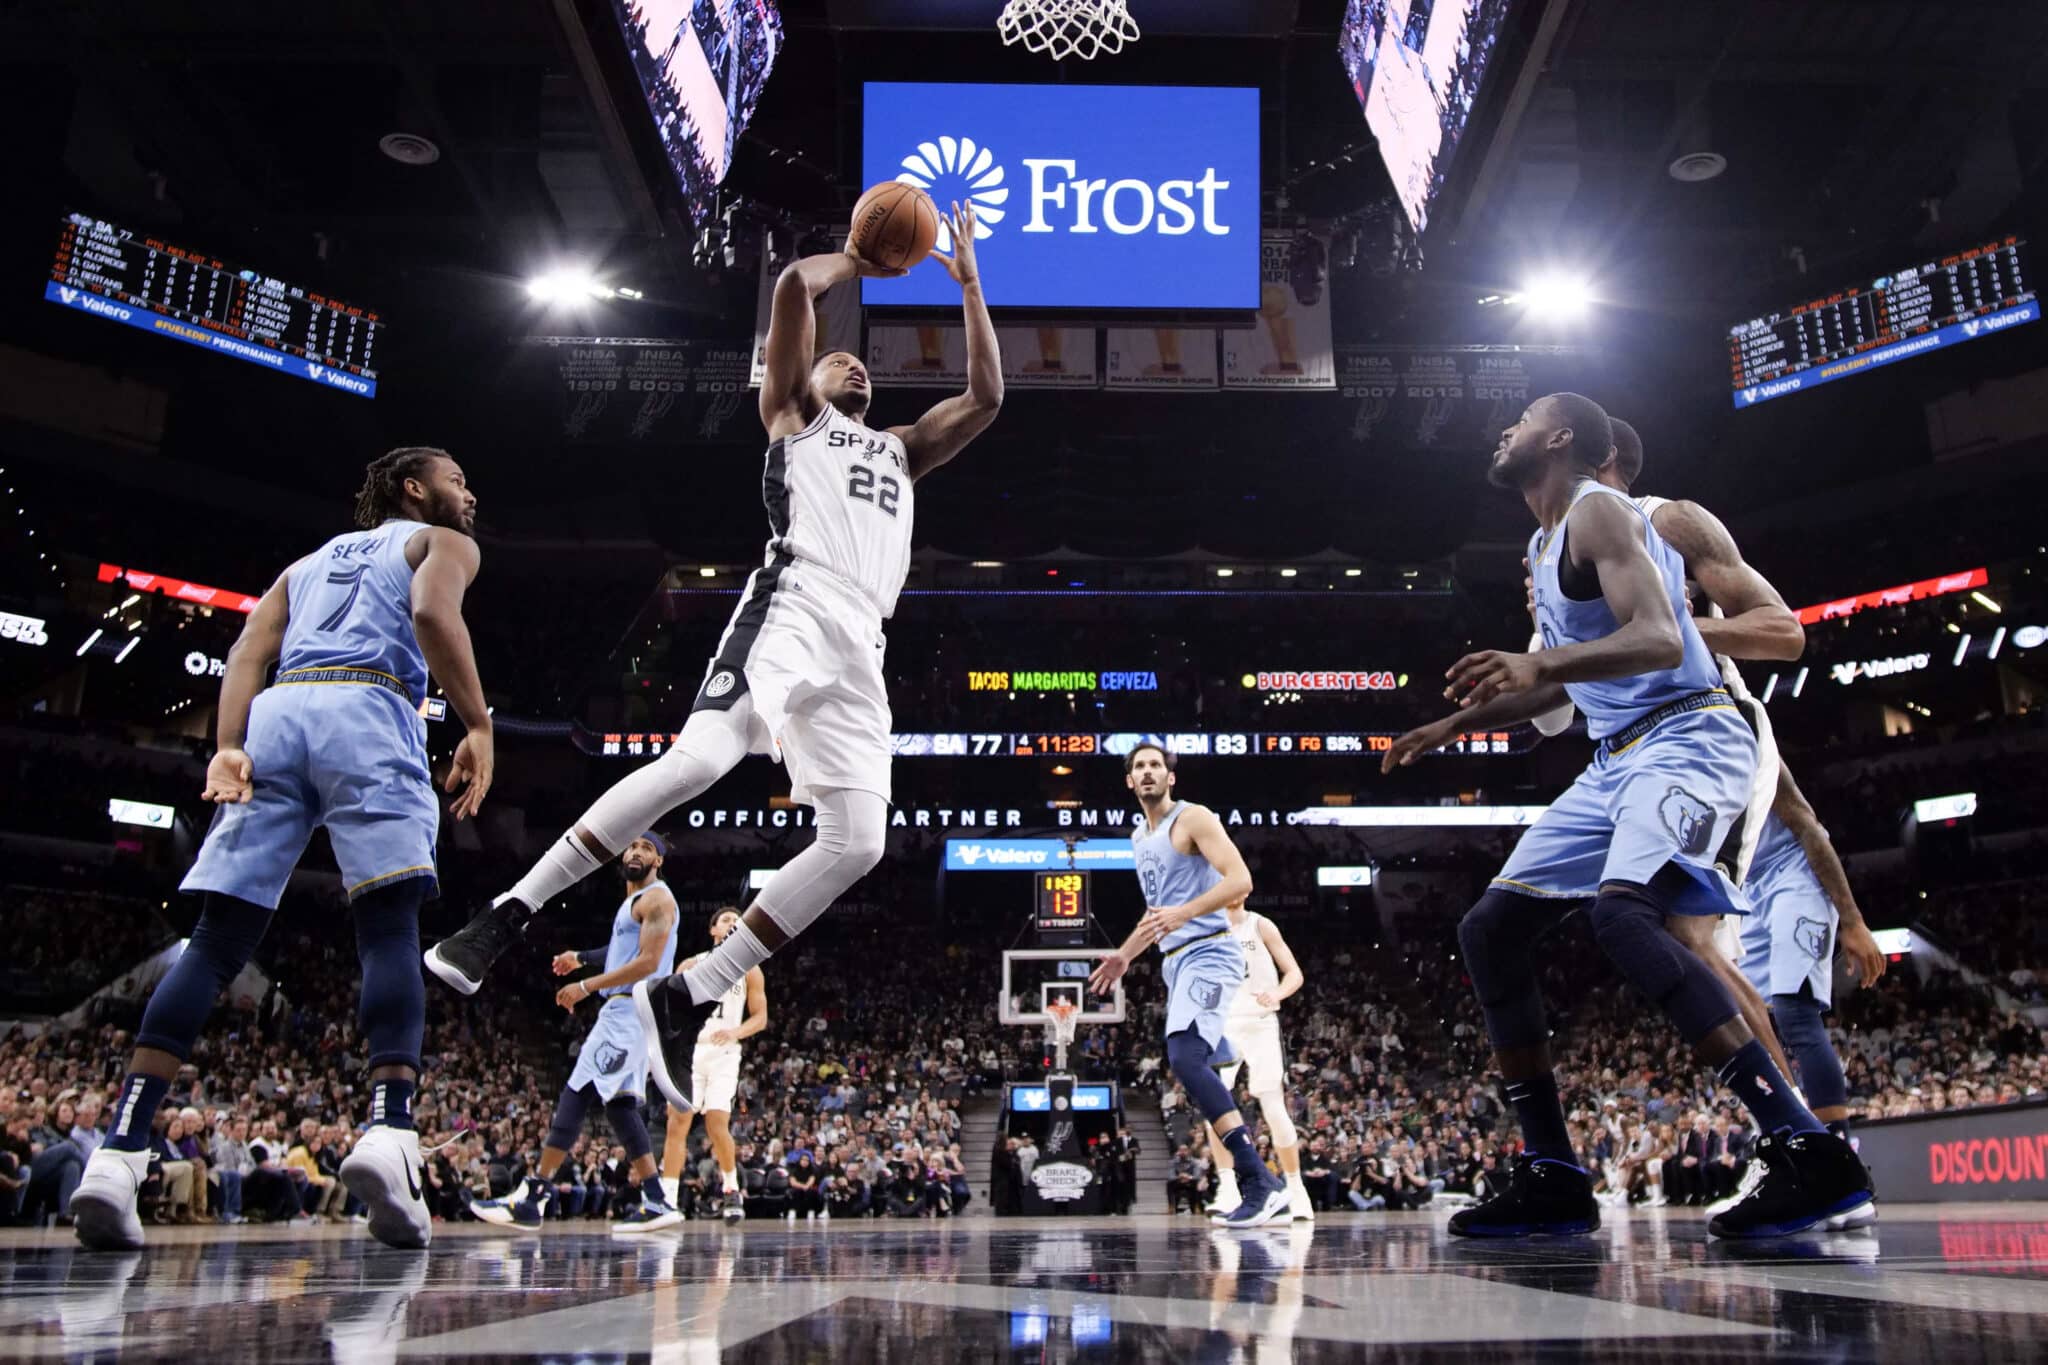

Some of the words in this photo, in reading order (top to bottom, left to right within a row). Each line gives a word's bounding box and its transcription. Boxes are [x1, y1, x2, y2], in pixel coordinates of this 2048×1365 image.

[1022, 158, 1230, 236] Frost
[90, 228, 118, 246] WHITE
[96, 220, 113, 235] SA
[120, 229, 133, 240] 77
[87, 239, 122, 258] FORBES
[82, 260, 102, 272] GAY
[83, 249, 128, 271] ALDRIDGE
[80, 270, 123, 291] BERTANS
[1897, 267, 1919, 281] MEM
[257, 286, 285, 301] GREEN
[264, 277, 286, 293] MEM
[1894, 278, 1921, 293] GREEN
[81, 294, 131, 321] Valero
[1900, 293, 1933, 311] BROOKS
[257, 305, 291, 323] BROOKS
[1901, 303, 1932, 320] CONLEY
[1984, 309, 2031, 330] Valero
[255, 315, 288, 332] CONLEY
[1748, 325, 1772, 340] WHITE
[1750, 318, 1764, 330] SA
[212, 336, 284, 366] PERFORMANCE
[1871, 335, 1941, 363] PERFORMANCE
[326, 371, 370, 394] Valero
[893, 370, 934, 379] ANTONIO
[1226, 376, 1248, 384] SAN
[1252, 376, 1297, 384] ANTONIO
[629, 381, 685, 392] 2003
[1344, 387, 1397, 398] 2007
[1408, 387, 1463, 398] 2013
[1475, 389, 1531, 400] 2014
[1760, 378, 1802, 397] Valero
[848, 464, 900, 518] 22
[316, 563, 371, 632] 7
[1862, 652, 1928, 679] Valero
[968, 672, 1009, 691] TACOS
[1013, 671, 1097, 691] MARGARITAS
[627, 734, 644, 742] AST
[933, 734, 964, 754] SA
[971, 735, 1003, 755] 77
[1019, 735, 1028, 746] 4
[1037, 736, 1095, 753] 11:23
[1166, 734, 1208, 754] MEM
[1215, 734, 1247, 754] 83
[1268, 737, 1278, 751] F
[1279, 737, 1292, 751] 0
[1300, 737, 1321, 751] FG
[1327, 737, 1362, 752] 52%
[891, 810, 1022, 828] ARTNER
[985, 847, 1047, 864] Valero
[1046, 874, 1082, 892] 11:23
[1055, 892, 1078, 916] 13
[1052, 918, 1086, 928] TISSOT
[1046, 1168, 1079, 1177] BRAKE
[1046, 1178, 1079, 1186] CHECK
